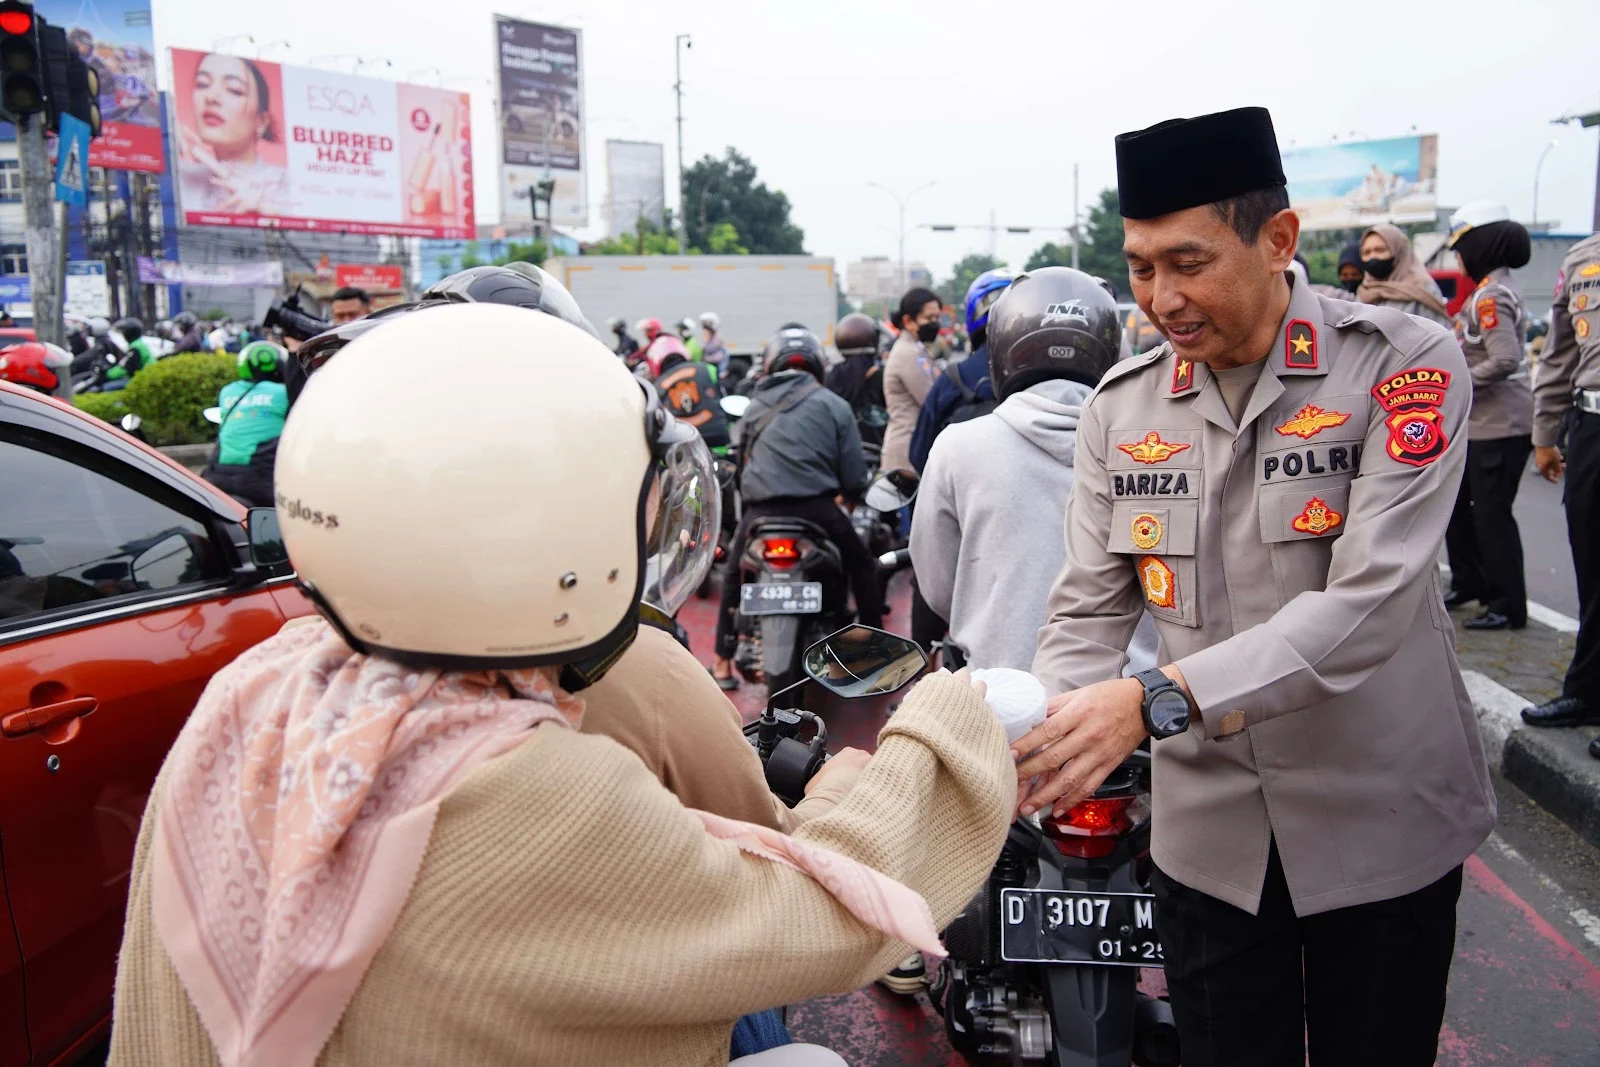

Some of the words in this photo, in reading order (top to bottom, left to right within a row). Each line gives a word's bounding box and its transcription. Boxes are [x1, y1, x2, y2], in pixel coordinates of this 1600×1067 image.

[306, 84, 376, 117] ESQA
[292, 125, 393, 152] BLURRED
[318, 148, 373, 166] HAZE
[1046, 304, 1089, 317] INK
[1051, 347, 1072, 357] DOT
[1379, 371, 1443, 396] POLDA
[1388, 393, 1412, 406] JAWA
[1412, 392, 1439, 402] BARAT
[1264, 444, 1360, 481] POLRI
[1114, 472, 1189, 496] BARIZA
[743, 586, 753, 600] Z
[1008, 896, 1025, 925] D
[1047, 897, 1111, 928] 3107
[1134, 899, 1156, 930] M
